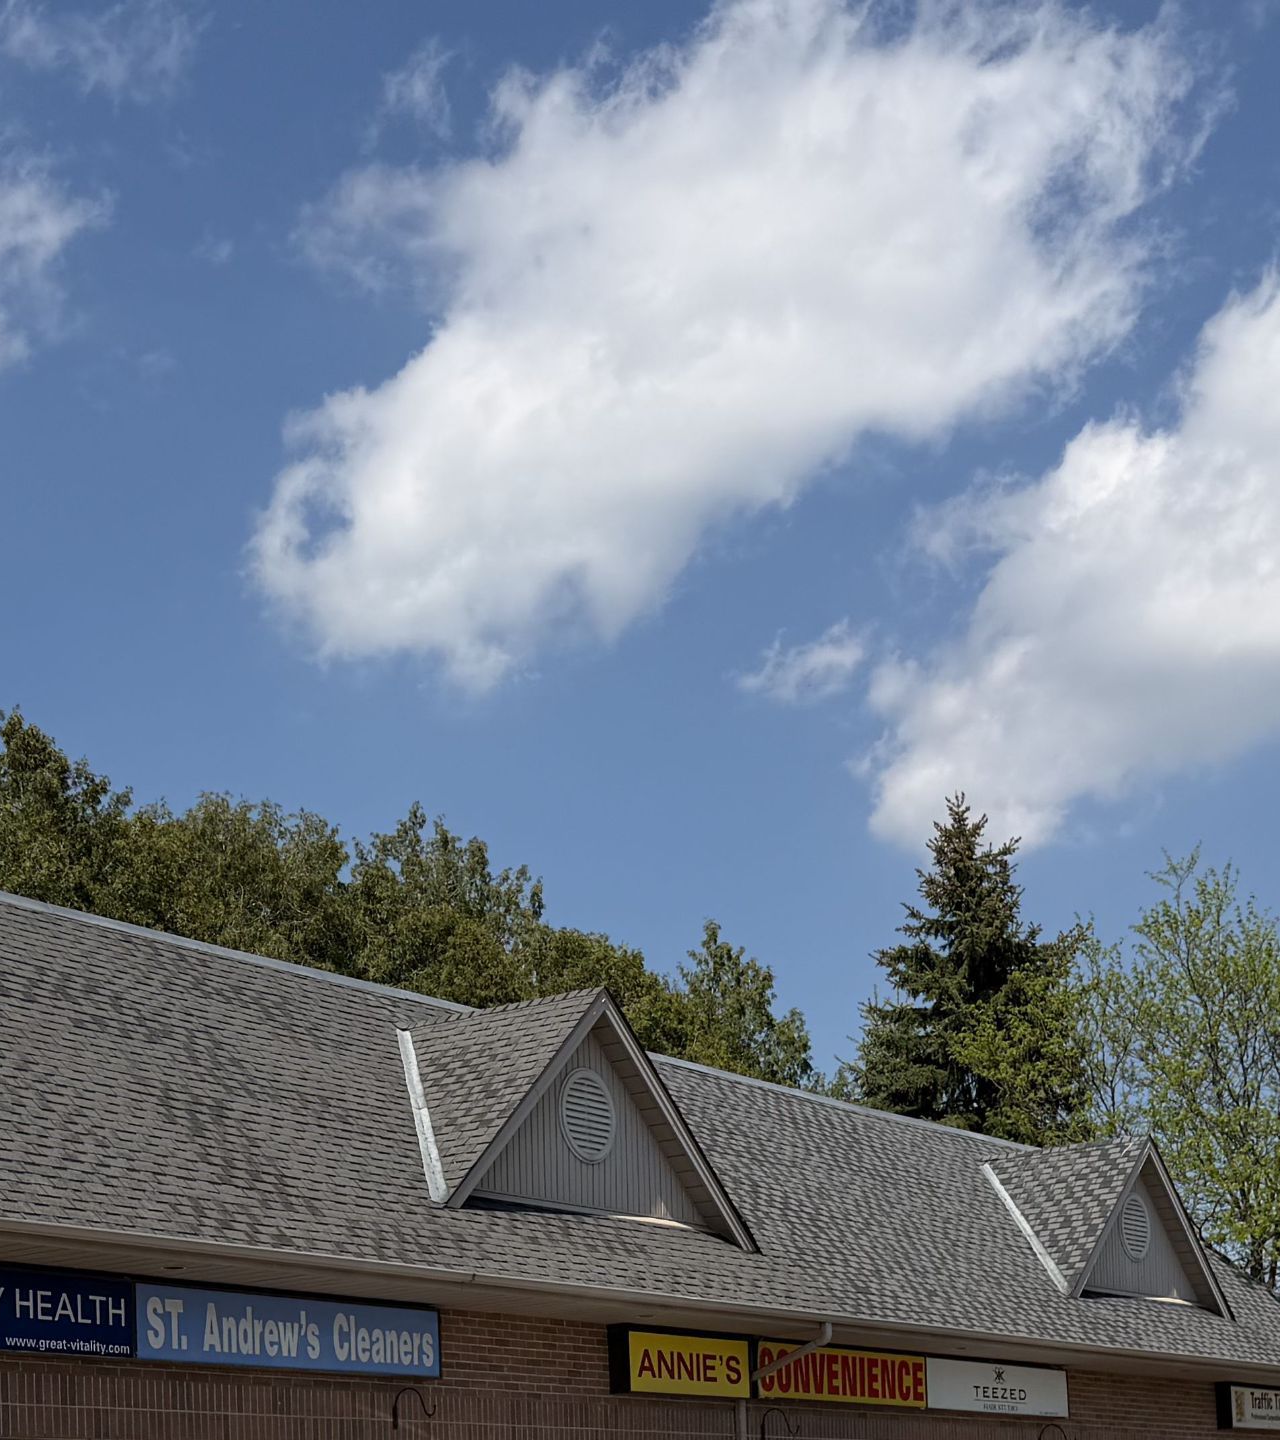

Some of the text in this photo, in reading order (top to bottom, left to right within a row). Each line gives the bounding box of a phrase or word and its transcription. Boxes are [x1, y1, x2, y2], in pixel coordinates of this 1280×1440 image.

[14, 1287, 126, 1328] HEALTH
[4, 1335, 130, 1356] www.great-vitality.com
[146, 1296, 434, 1368] ST. Andrew's Cleaners
[638, 1349, 742, 1385] ANNIE'S
[760, 1347, 923, 1401] CONVENIENCE
[973, 1385, 1027, 1401] TEEZED
[1250, 1391, 1272, 1410] Traffic
